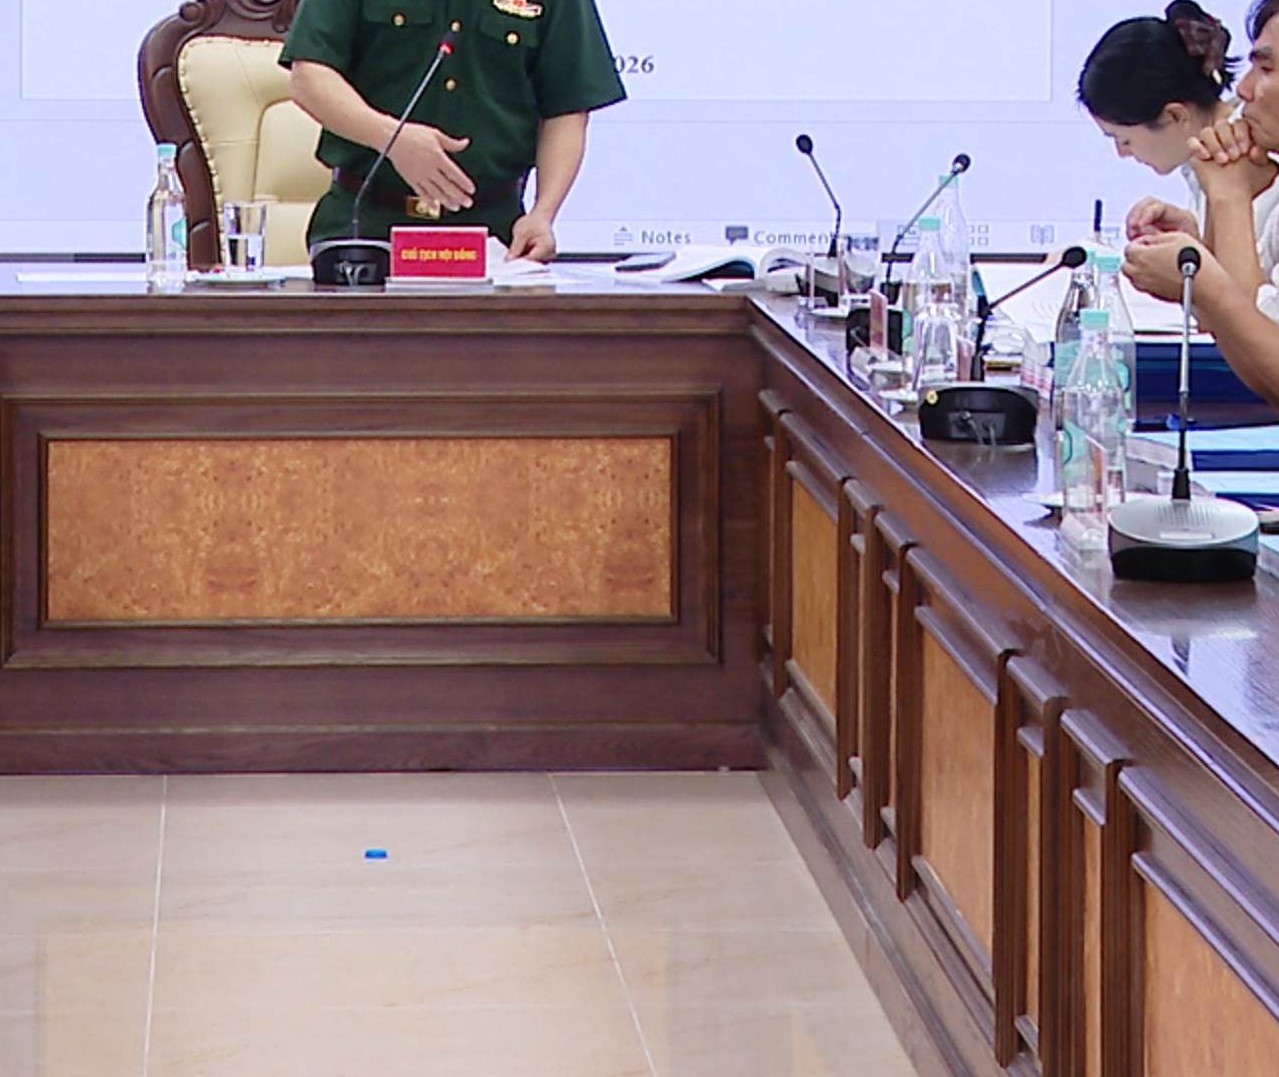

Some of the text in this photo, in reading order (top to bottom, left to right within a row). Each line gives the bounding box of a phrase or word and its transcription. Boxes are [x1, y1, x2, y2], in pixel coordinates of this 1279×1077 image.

[615, 55, 655, 74] 026
[642, 231, 690, 244] Notes
[754, 231, 829, 246] Commen
